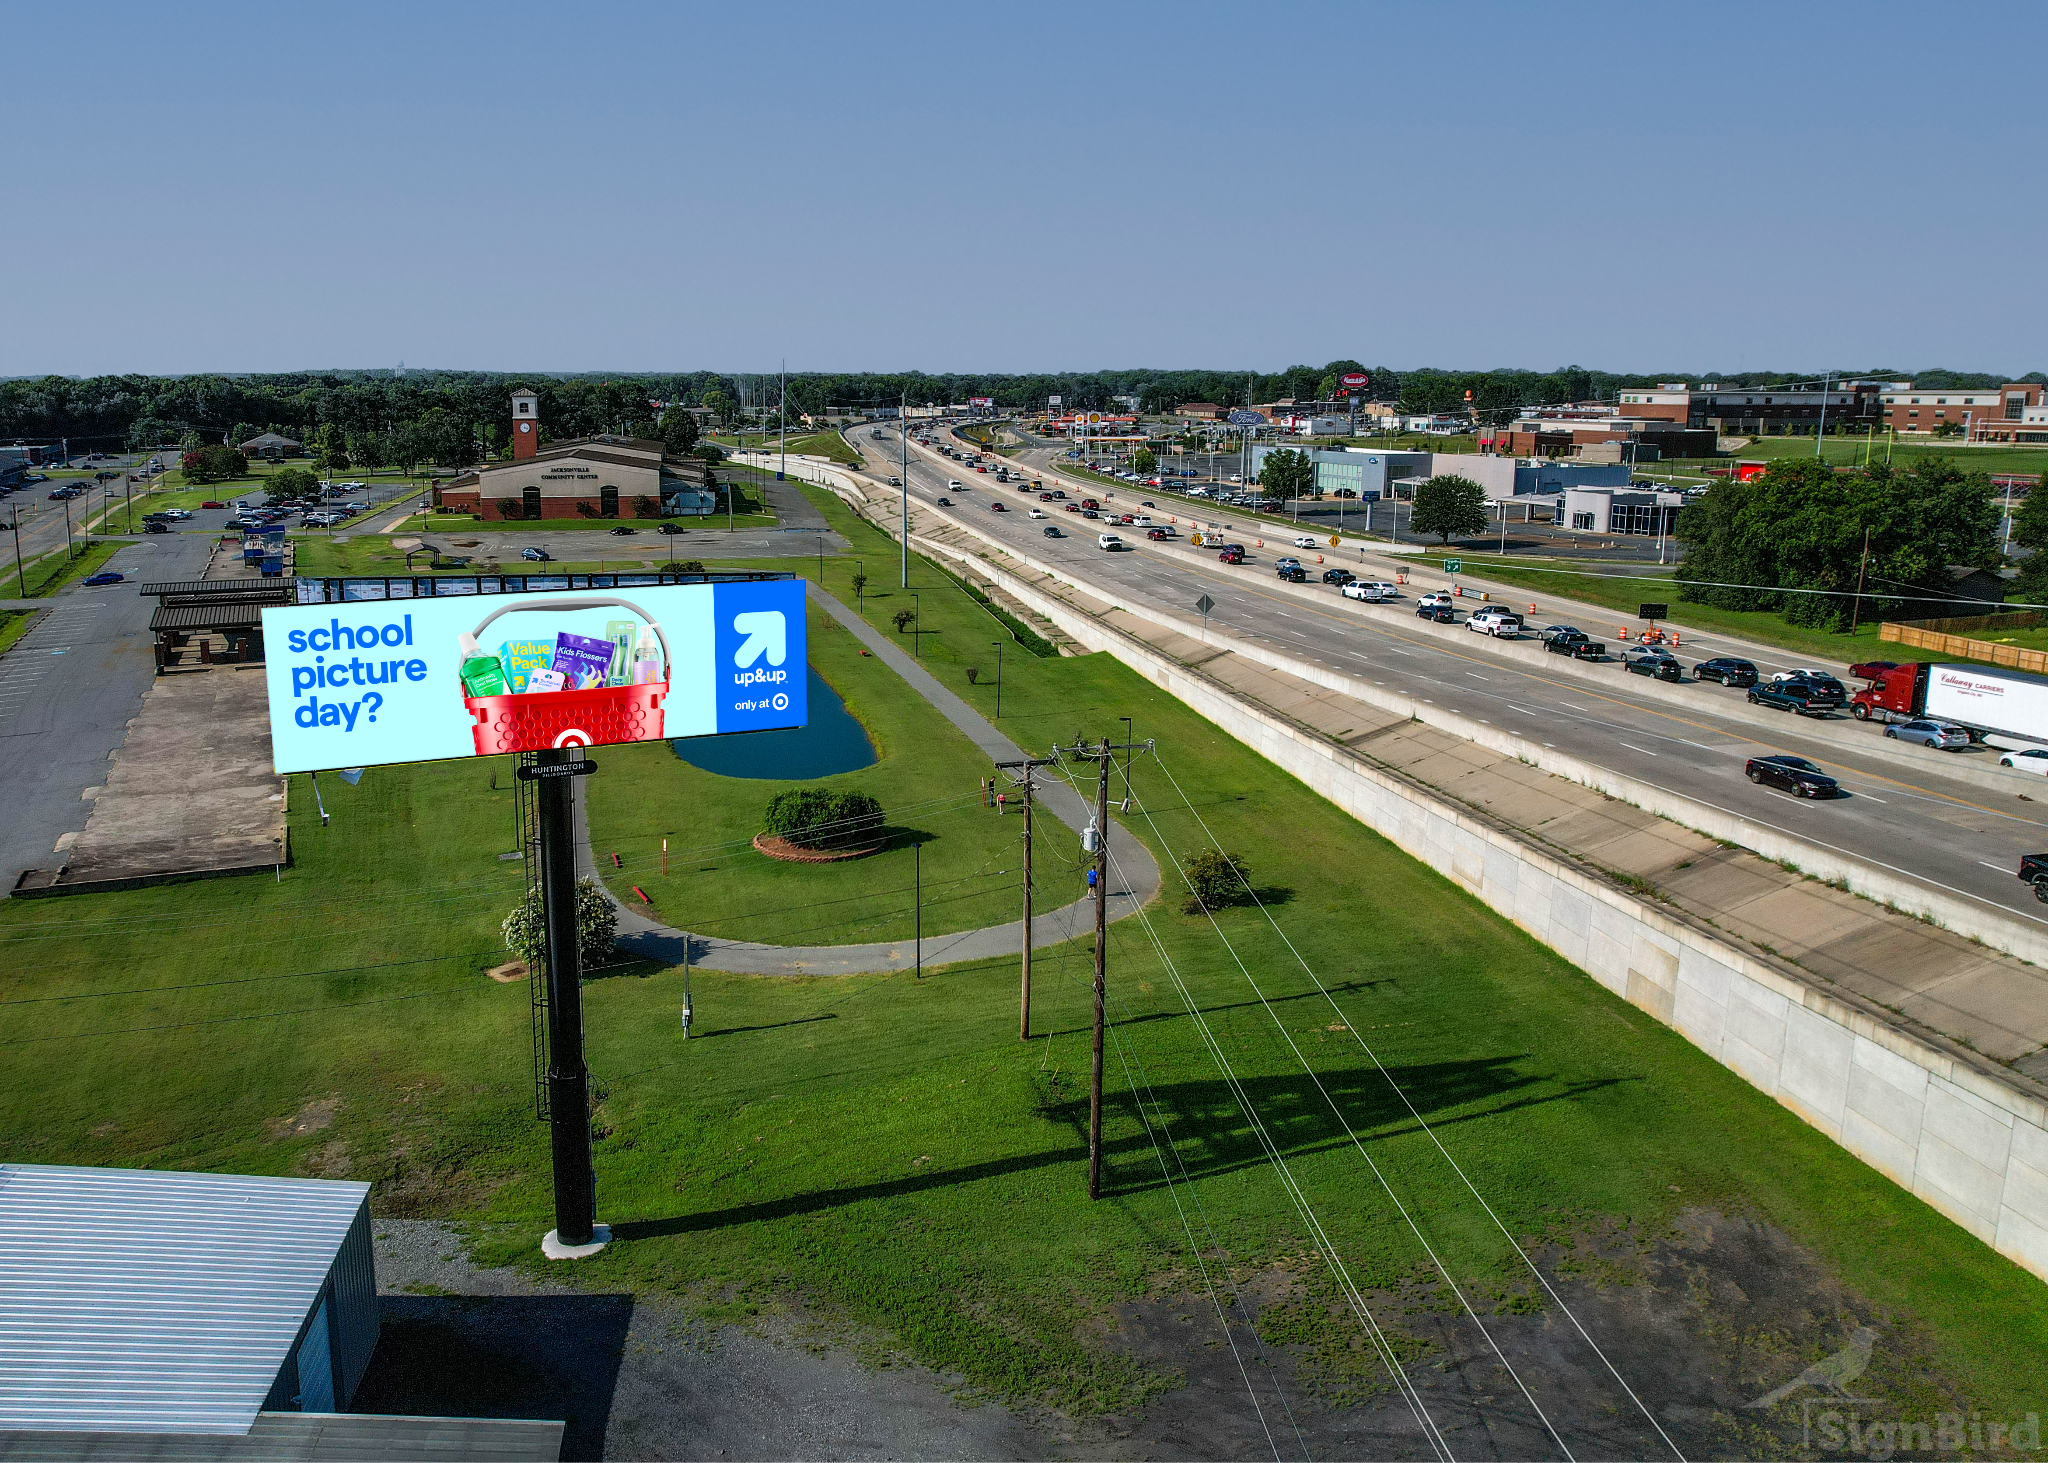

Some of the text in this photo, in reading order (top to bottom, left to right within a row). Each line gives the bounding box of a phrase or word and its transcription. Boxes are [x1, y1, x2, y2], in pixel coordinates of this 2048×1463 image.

[1236, 413, 1258, 424] Ford
[288, 614, 413, 653] school
[508, 641, 551, 656] Value
[558, 646, 575, 657] Kids
[575, 650, 608, 663] Flossers
[511, 655, 549, 671] Pack
[291, 655, 428, 698] picture
[734, 667, 787, 687] up&up
[1940, 673, 2004, 694] Callaway CARRIERS
[294, 691, 384, 733] day?
[734, 698, 770, 711] only at
[531, 762, 584, 774] HUNTINGTON
